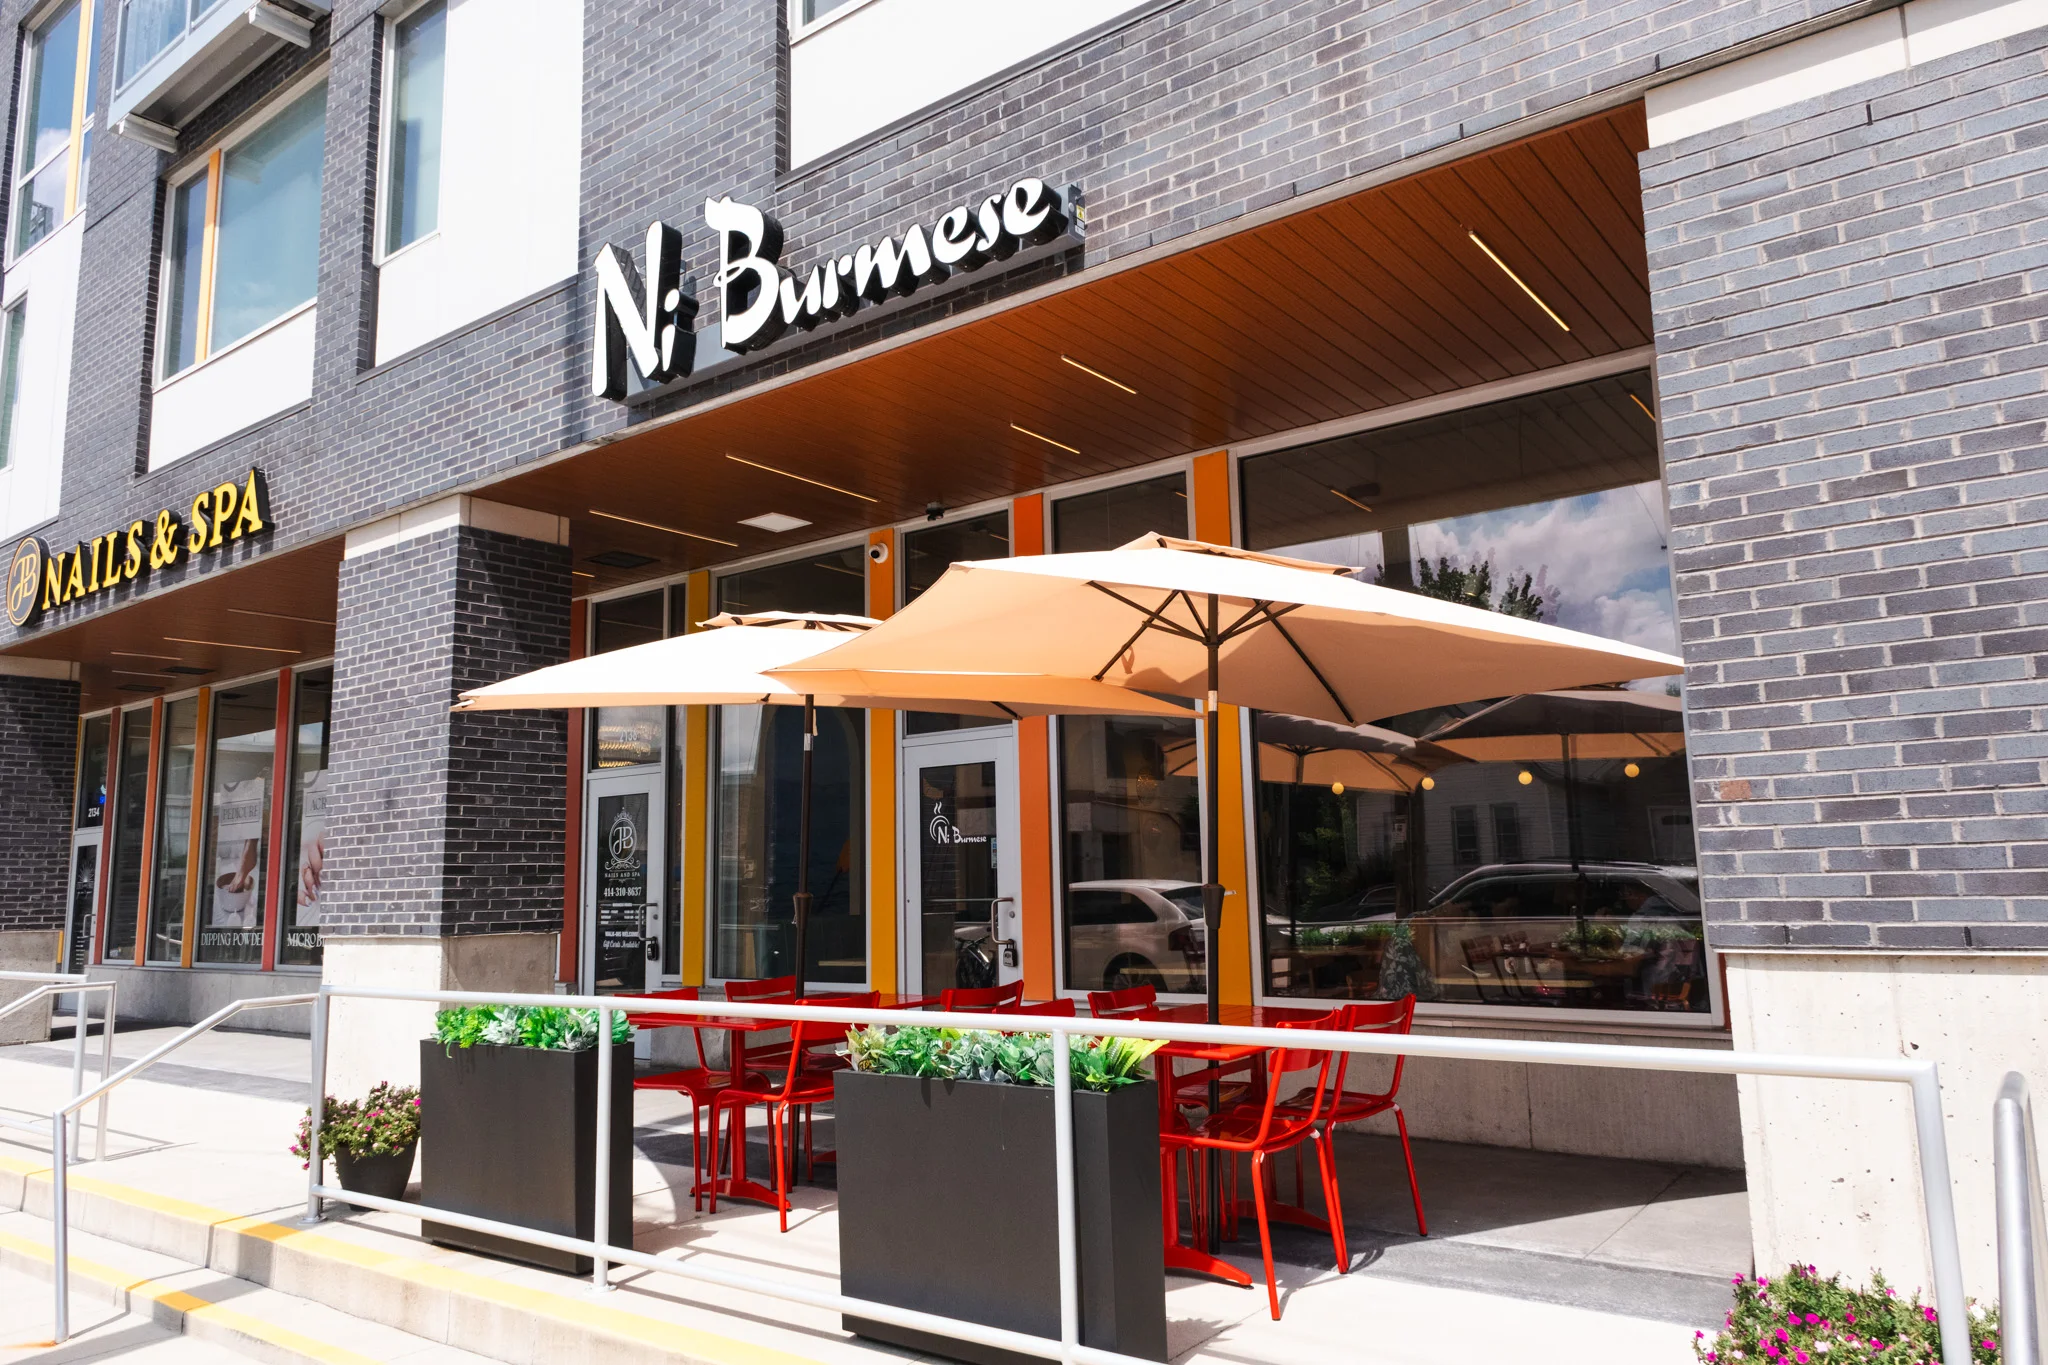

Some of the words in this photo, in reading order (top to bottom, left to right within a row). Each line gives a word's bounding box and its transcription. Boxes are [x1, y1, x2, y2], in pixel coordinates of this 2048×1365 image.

[592, 219, 682, 398] Ni
[704, 176, 1052, 350] Burmese
[42, 519, 144, 611] NAILS
[150, 508, 178, 570] &
[188, 468, 263, 554] SPA
[88, 807, 100, 818] 2134
[937, 825, 950, 844] Ni
[951, 825, 987, 844] Burmese
[603, 886, 642, 897] 414-310-8637
[200, 932, 231, 946] DIPPING
[233, 932, 264, 946] POWDE
